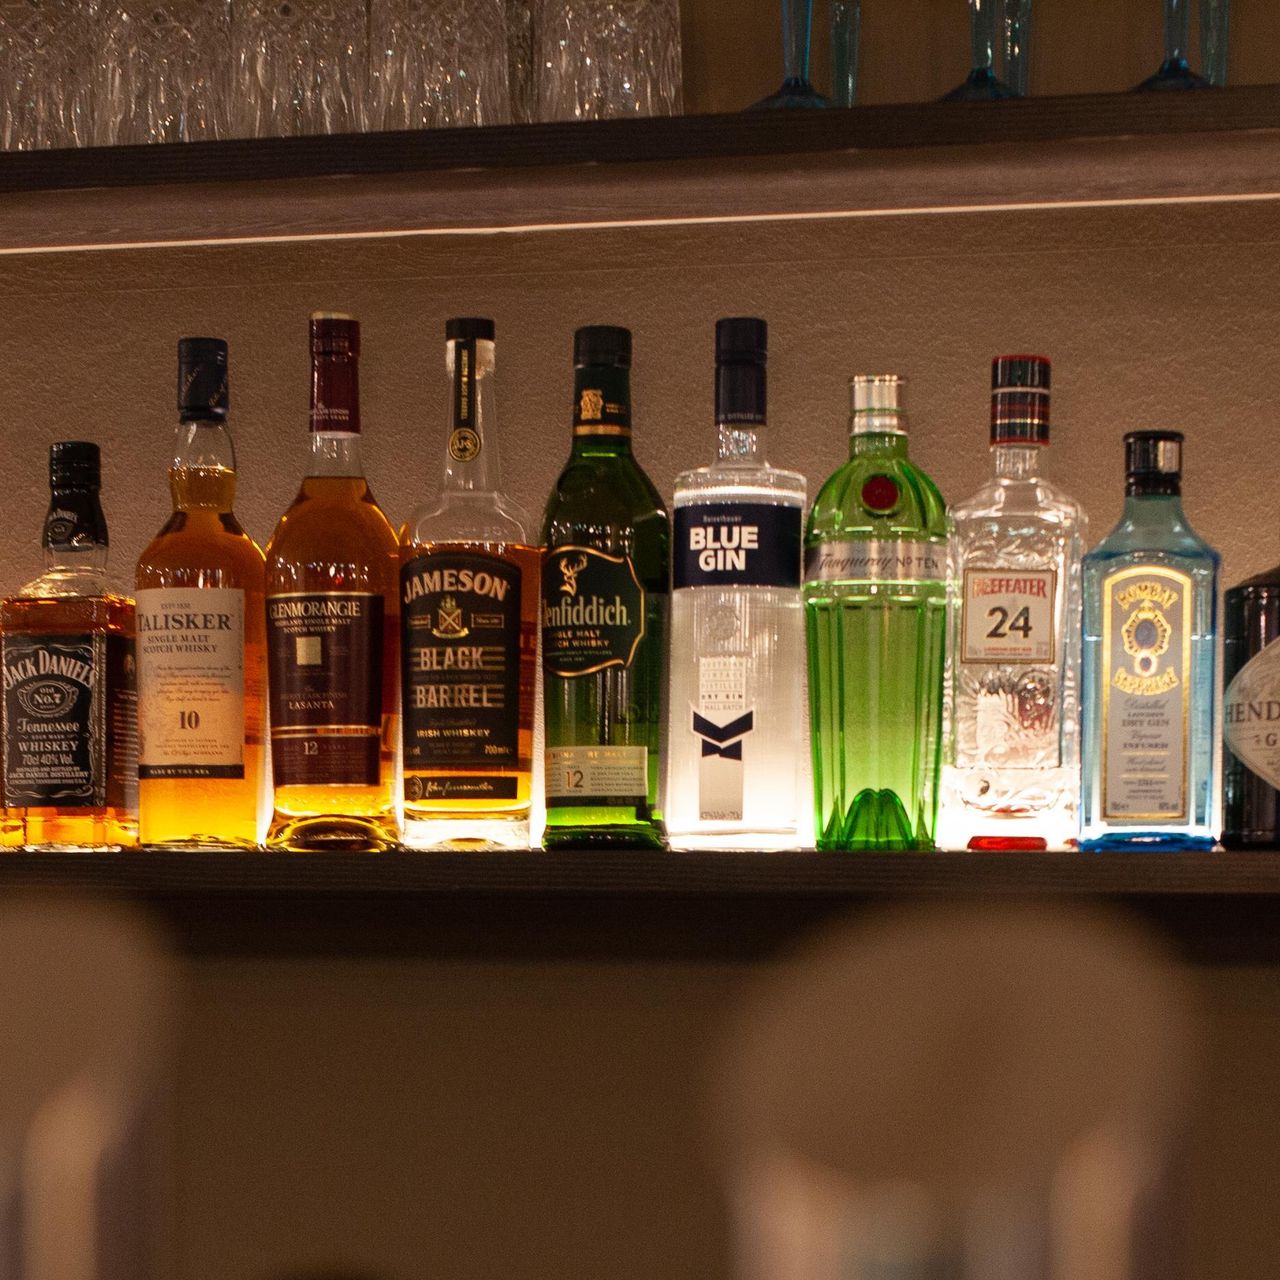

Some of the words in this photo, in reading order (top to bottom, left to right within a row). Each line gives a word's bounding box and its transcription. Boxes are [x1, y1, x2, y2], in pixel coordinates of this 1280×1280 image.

[690, 526, 759, 551] BLUE
[699, 549, 746, 572] GIN
[819, 553, 892, 572] Tanqueray
[915, 557, 939, 569] TEN
[404, 569, 508, 603] JAMESON
[973, 578, 1047, 598] BEEFEATER
[1115, 581, 1179, 610] BOMBAY
[137, 613, 231, 632] TALISKER
[986, 606, 1033, 639] 24
[176, 644, 218, 653] WHISKY
[420, 646, 484, 671] BLACK
[1, 657, 39, 690] JACK
[416, 684, 493, 708] BARREL
[17, 718, 80, 733] Tennessee
[179, 710, 201, 730] 10
[442, 729, 490, 738] WHISKEY
[18, 740, 79, 752] WHISKEY
[303, 742, 319, 756] 12
[566, 770, 584, 788] 12
